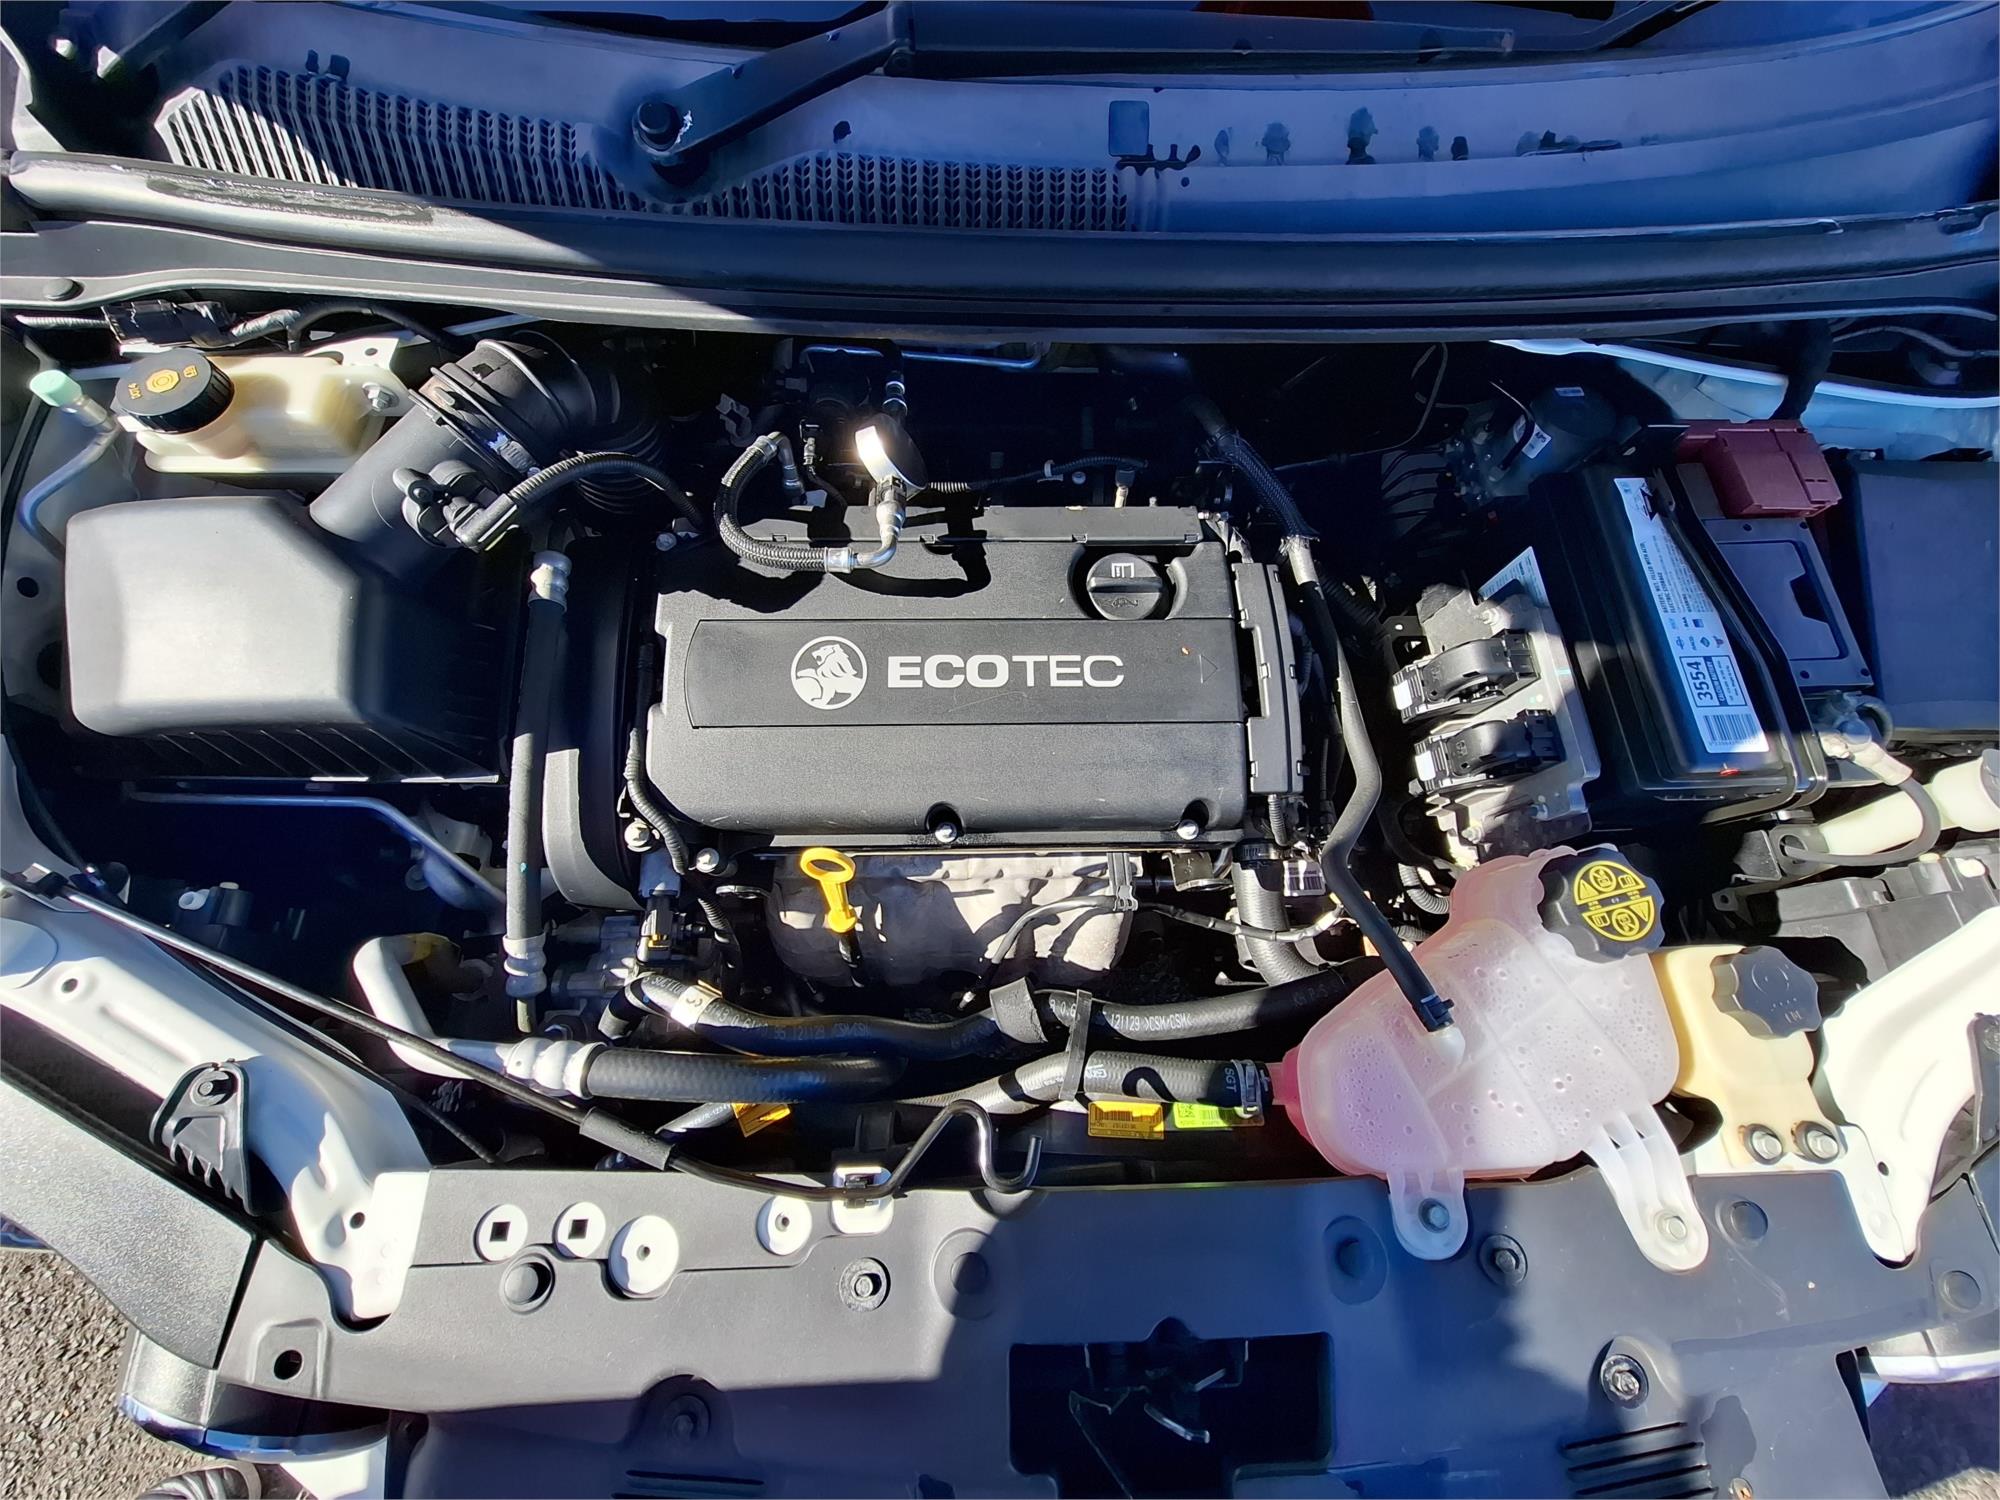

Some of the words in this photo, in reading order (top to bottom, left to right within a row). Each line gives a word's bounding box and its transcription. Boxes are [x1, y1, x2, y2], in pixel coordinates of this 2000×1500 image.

[887, 654, 1125, 689] ECOTEC
[1686, 661, 1713, 701] 3554
[1224, 1067, 1237, 1093] SGT
